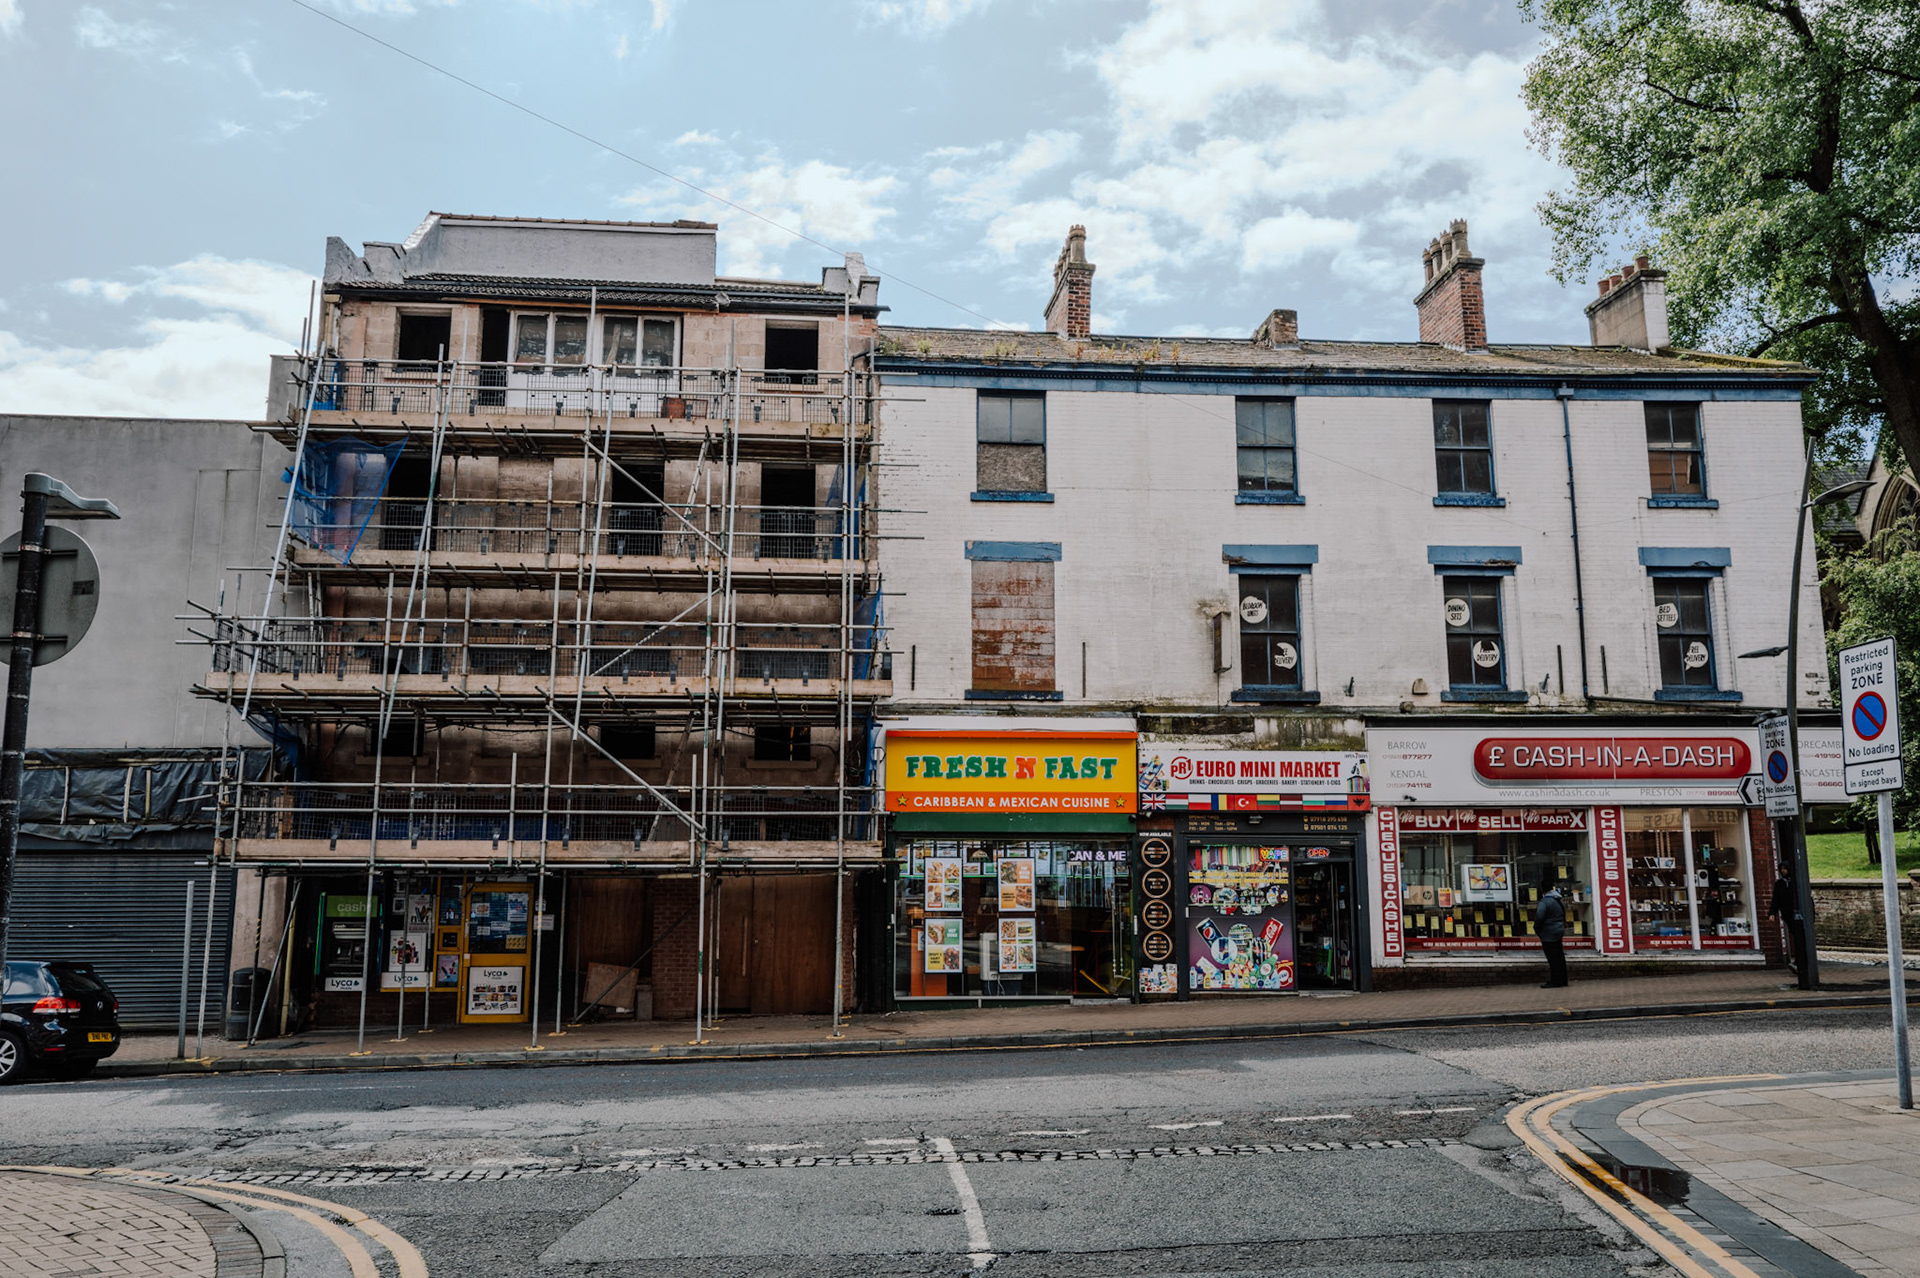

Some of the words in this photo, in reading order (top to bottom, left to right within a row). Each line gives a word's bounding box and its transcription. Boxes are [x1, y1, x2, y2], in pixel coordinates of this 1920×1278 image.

[1448, 604, 1466, 612] DINING
[1658, 605, 1671, 614] BED
[1844, 645, 1889, 665] Restricted
[1850, 661, 1883, 677] parking
[1851, 672, 1884, 690] ZONE
[1387, 741, 1427, 750] BARROW
[1765, 737, 1786, 749] ZONE
[1489, 746, 1506, 768] £
[1513, 745, 1736, 768] CASH-IN-A-DASH
[1848, 748, 1861, 758] No
[1863, 743, 1895, 756] loading
[905, 755, 1007, 779] FRESH
[1015, 757, 1037, 779] N
[1044, 756, 1118, 779] FAST
[1196, 760, 1236, 777] EURO
[1240, 761, 1276, 777] MINI
[1280, 761, 1341, 778] MARKET
[1861, 767, 1885, 777] Except
[1390, 769, 1428, 778] KENDAL
[1850, 780, 1857, 788] in
[1858, 777, 1880, 789] signed
[1881, 775, 1897, 786] bays
[1499, 788, 1611, 799] www.cashinadash.co.uk
[1640, 788, 1683, 797] PRESTON
[1775, 785, 1795, 793] loading
[913, 797, 985, 808] CARIBBEAN
[988, 797, 996, 808] &
[999, 797, 1058, 808] MEXICAN
[1062, 797, 1110, 808] CUISINE
[1399, 810, 1415, 823] We
[1415, 815, 1454, 828] BUY
[1460, 810, 1477, 823] We
[1478, 815, 1521, 828] SELL
[1600, 809, 1620, 881] CHEQUES
[1261, 849, 1289, 860] VAPE
[1308, 848, 1329, 858] OPEN
[1605, 885, 1625, 949] CASHED
[331, 978, 353, 988] Lyca
